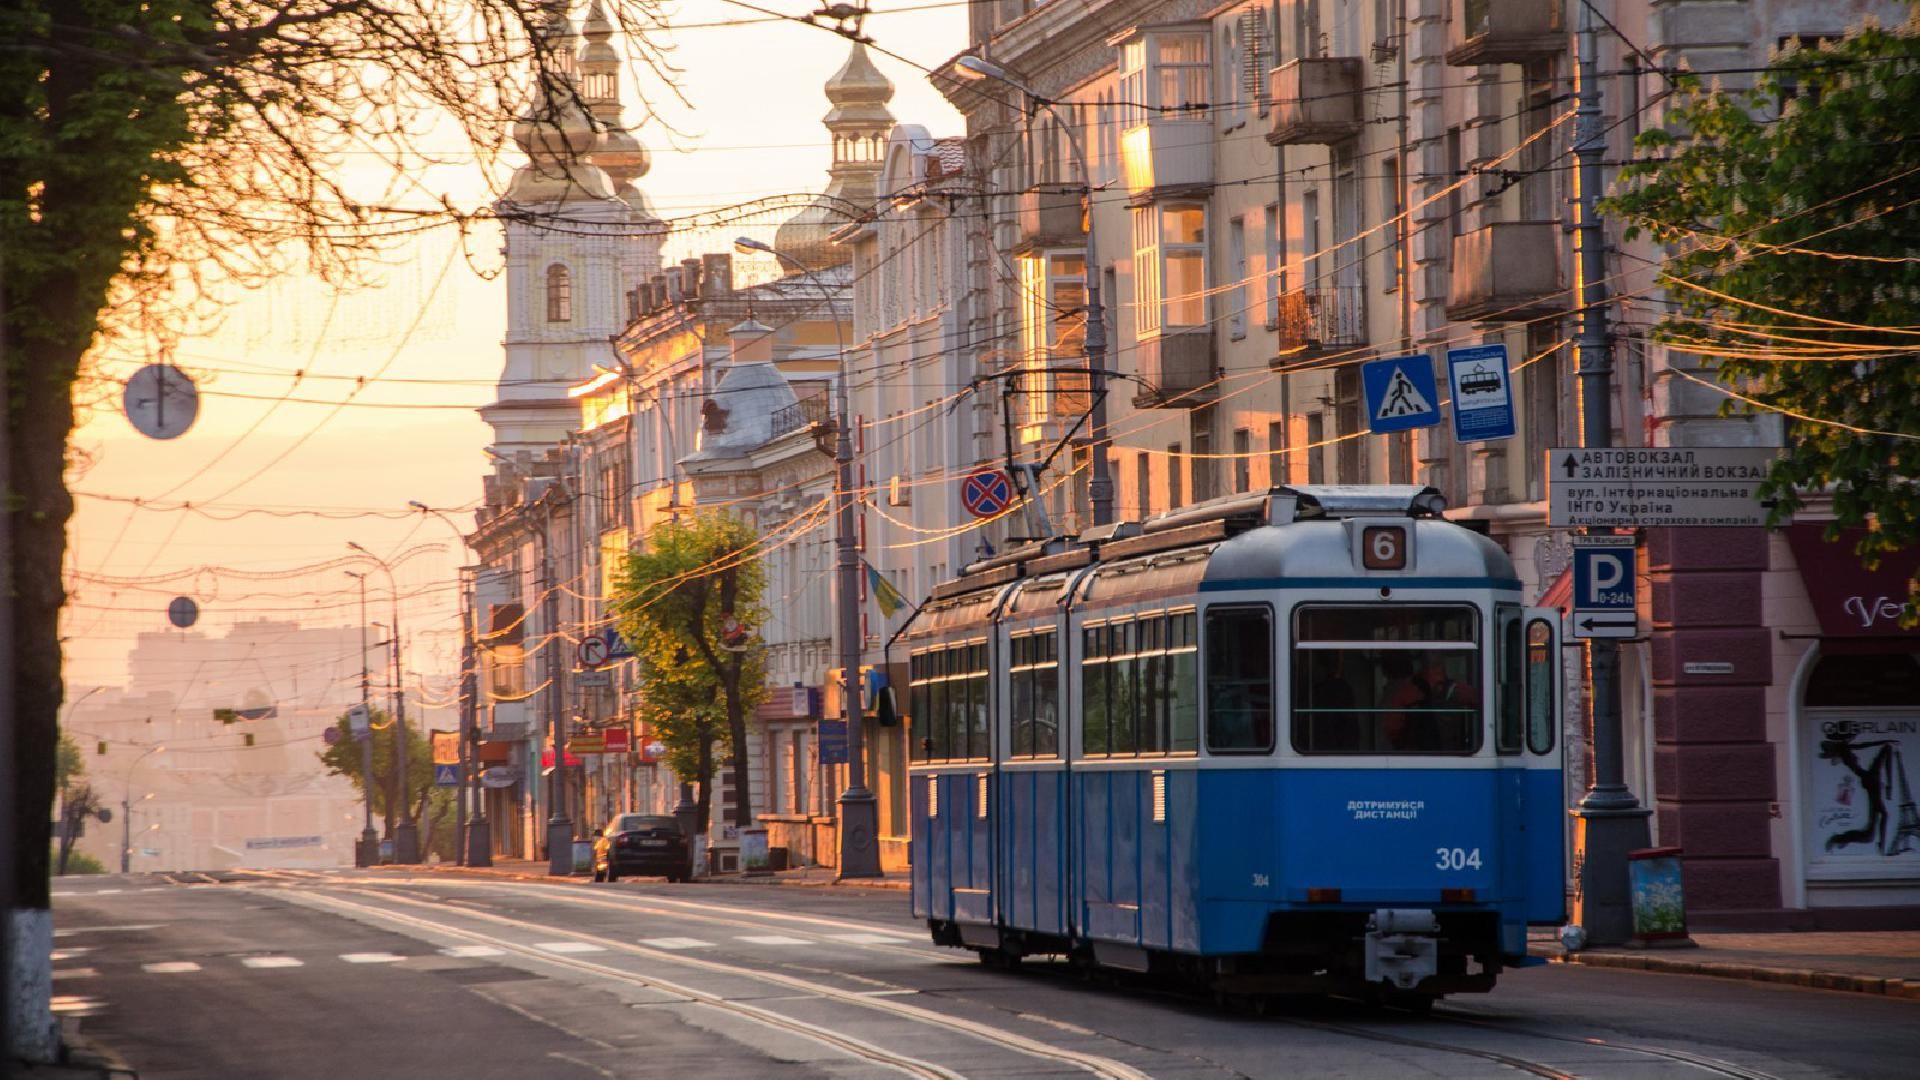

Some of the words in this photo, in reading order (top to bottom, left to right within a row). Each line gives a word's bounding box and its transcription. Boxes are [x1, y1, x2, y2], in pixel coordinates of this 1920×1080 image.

[1581, 451, 1695, 465] АВТОВОКЗАЛ
[1583, 464, 1699, 479] ЗАЛІЗНИЧНИЙ
[1568, 487, 1597, 500] вул.
[1603, 486, 1748, 500] Інтернаціональна
[1568, 501, 1604, 513] ІНГО
[1609, 501, 1673, 516] Україна
[1568, 515, 1638, 526] Акціонерна
[1641, 516, 1698, 526] страхова
[1373, 532, 1396, 561] 6
[1590, 554, 1623, 603] P
[1347, 801, 1424, 810] ДОТРИМУЙСЯ
[1354, 811, 1417, 819] ДИСТАНЦІЇ
[1435, 848, 1482, 870] 304
[1253, 873, 1269, 886] 304
